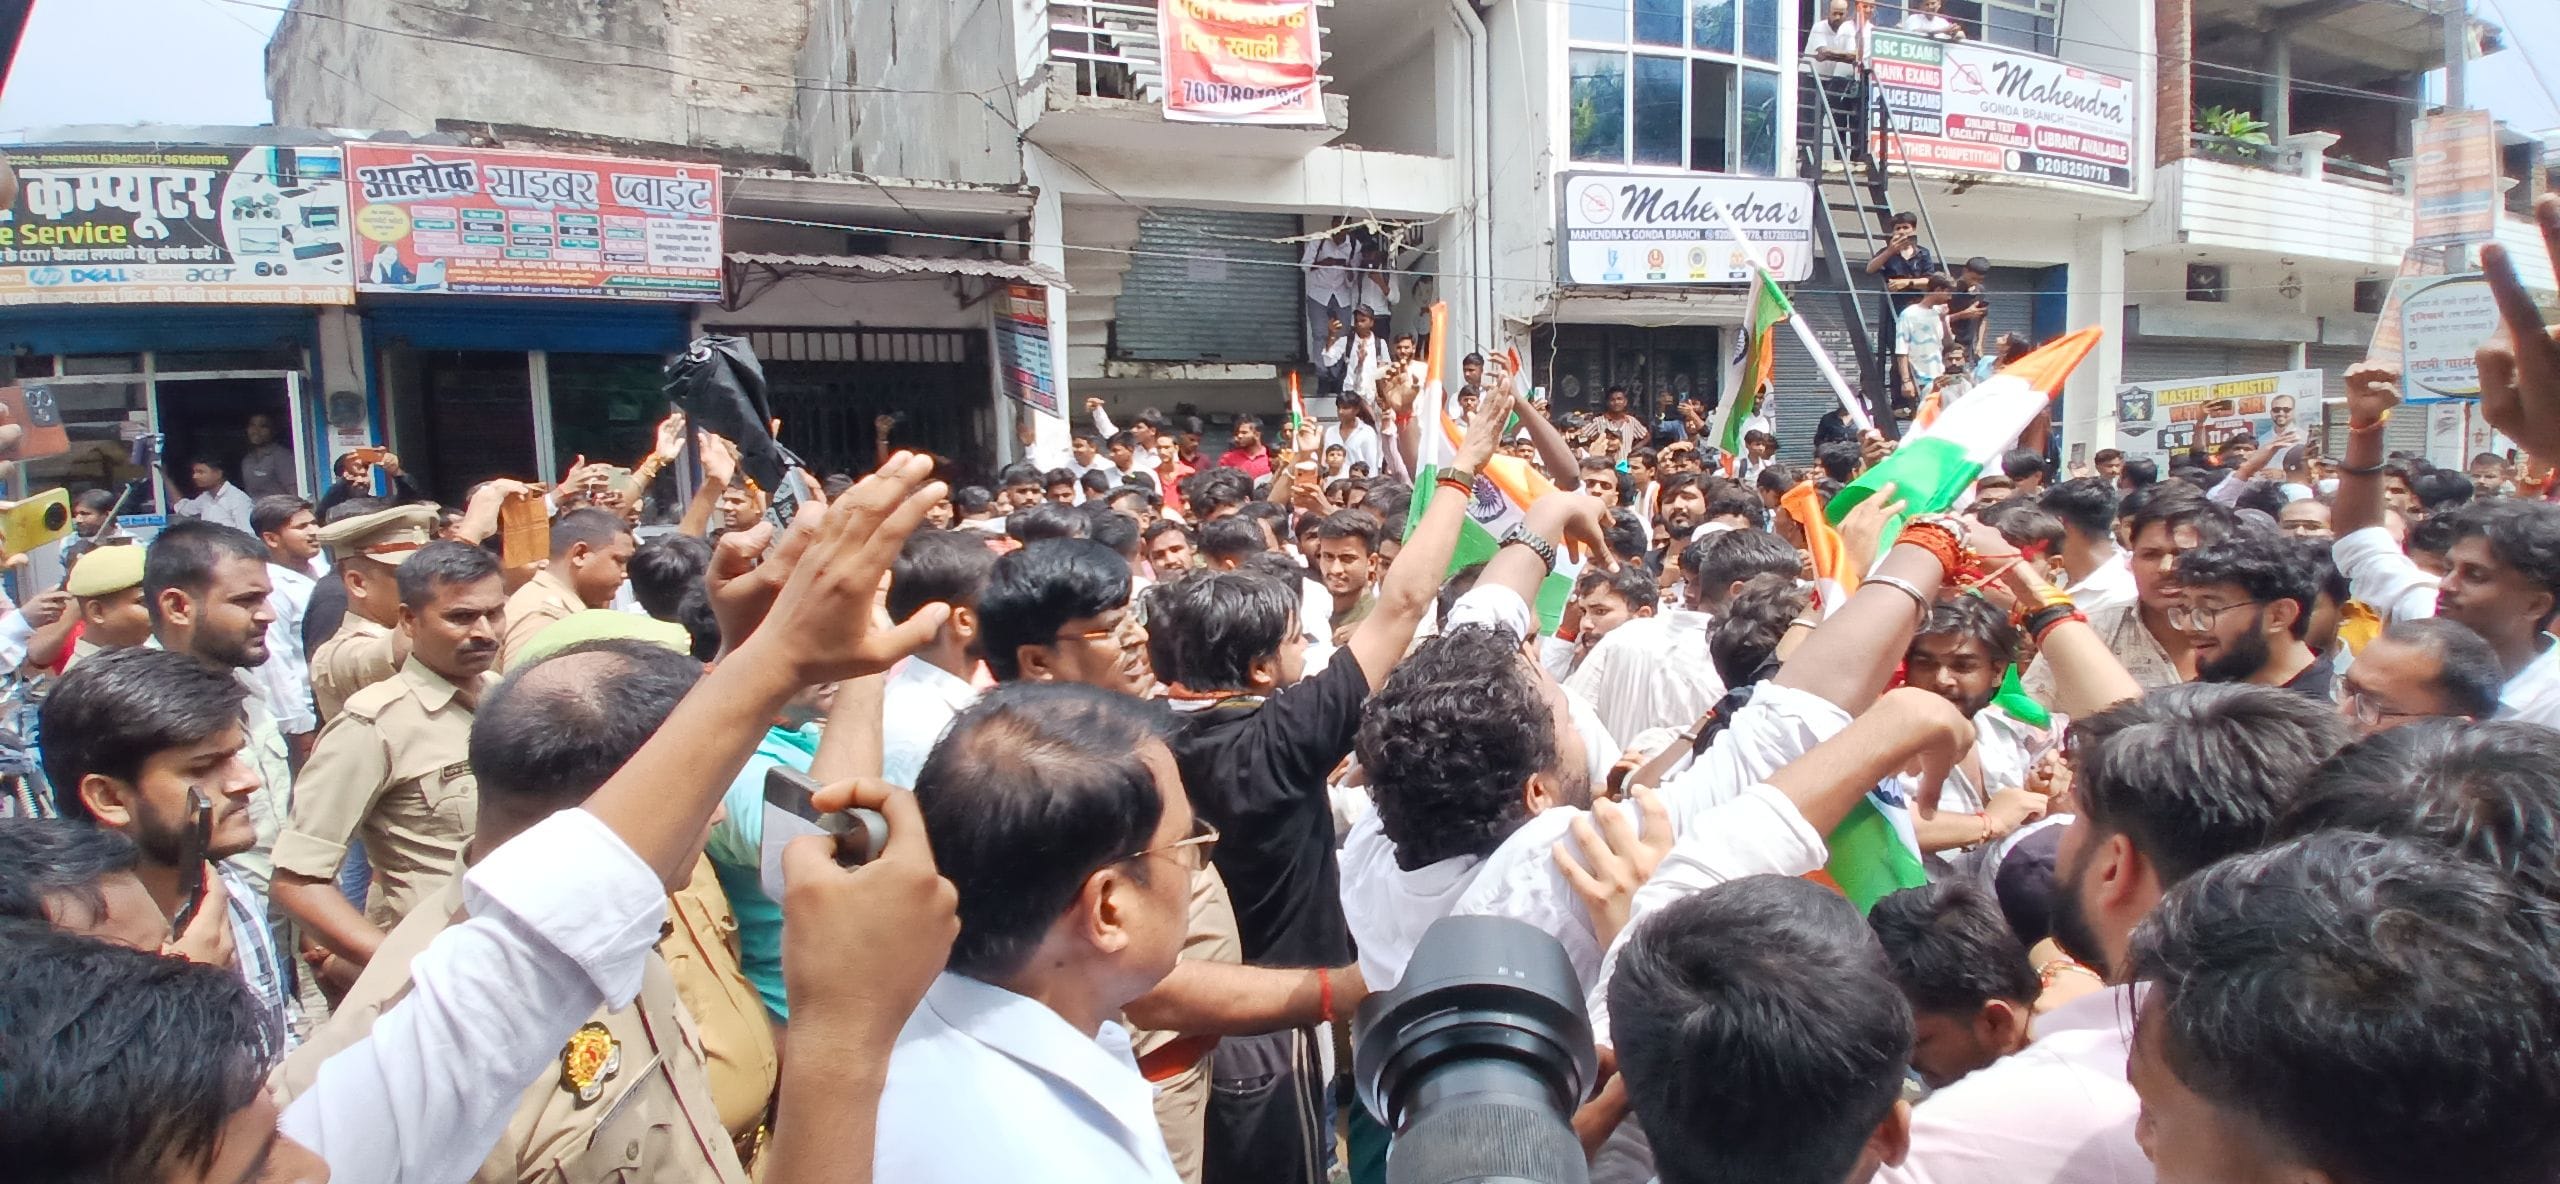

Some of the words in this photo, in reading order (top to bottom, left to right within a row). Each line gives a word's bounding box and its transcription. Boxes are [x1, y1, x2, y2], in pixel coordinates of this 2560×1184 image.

[1874, 39, 1898, 57] SSC
[1901, 43, 1941, 62] EXAMS
[1874, 63, 1904, 81] BANK
[1905, 68, 1940, 89] EXAMS
[1873, 87, 1908, 107] PLICE
[1909, 92, 1941, 110] EXAMS
[1979, 101, 2019, 116] GONDA
[2022, 107, 2064, 124] BRANCH
[1912, 117, 1940, 134] EXAMS
[1950, 127, 1987, 142] FACILITY
[1988, 132, 2030, 147] AVAILABLE
[1998, 122, 2017, 134] TEST
[1934, 145, 2000, 165] COMPETITION
[2038, 130, 2080, 151] LIBRARY
[2081, 138, 2127, 161] AVAILABLE
[358, 157, 476, 200] आलोक
[486, 167, 598, 204] साइबर
[2035, 156, 2111, 182] 9208250778
[20, 221, 127, 244] Service
[1570, 229, 1631, 241] MAHENDRA'S
[1632, 229, 1664, 241] GONDA
[1665, 229, 1701, 241] BRANCH
[20, 249, 51, 263] CCTV
[71, 267, 128, 283] DELL
[185, 267, 237, 283] acer
[2158, 386, 2208, 406] MASTER
[2209, 376, 2280, 400] CHEMISTRY
